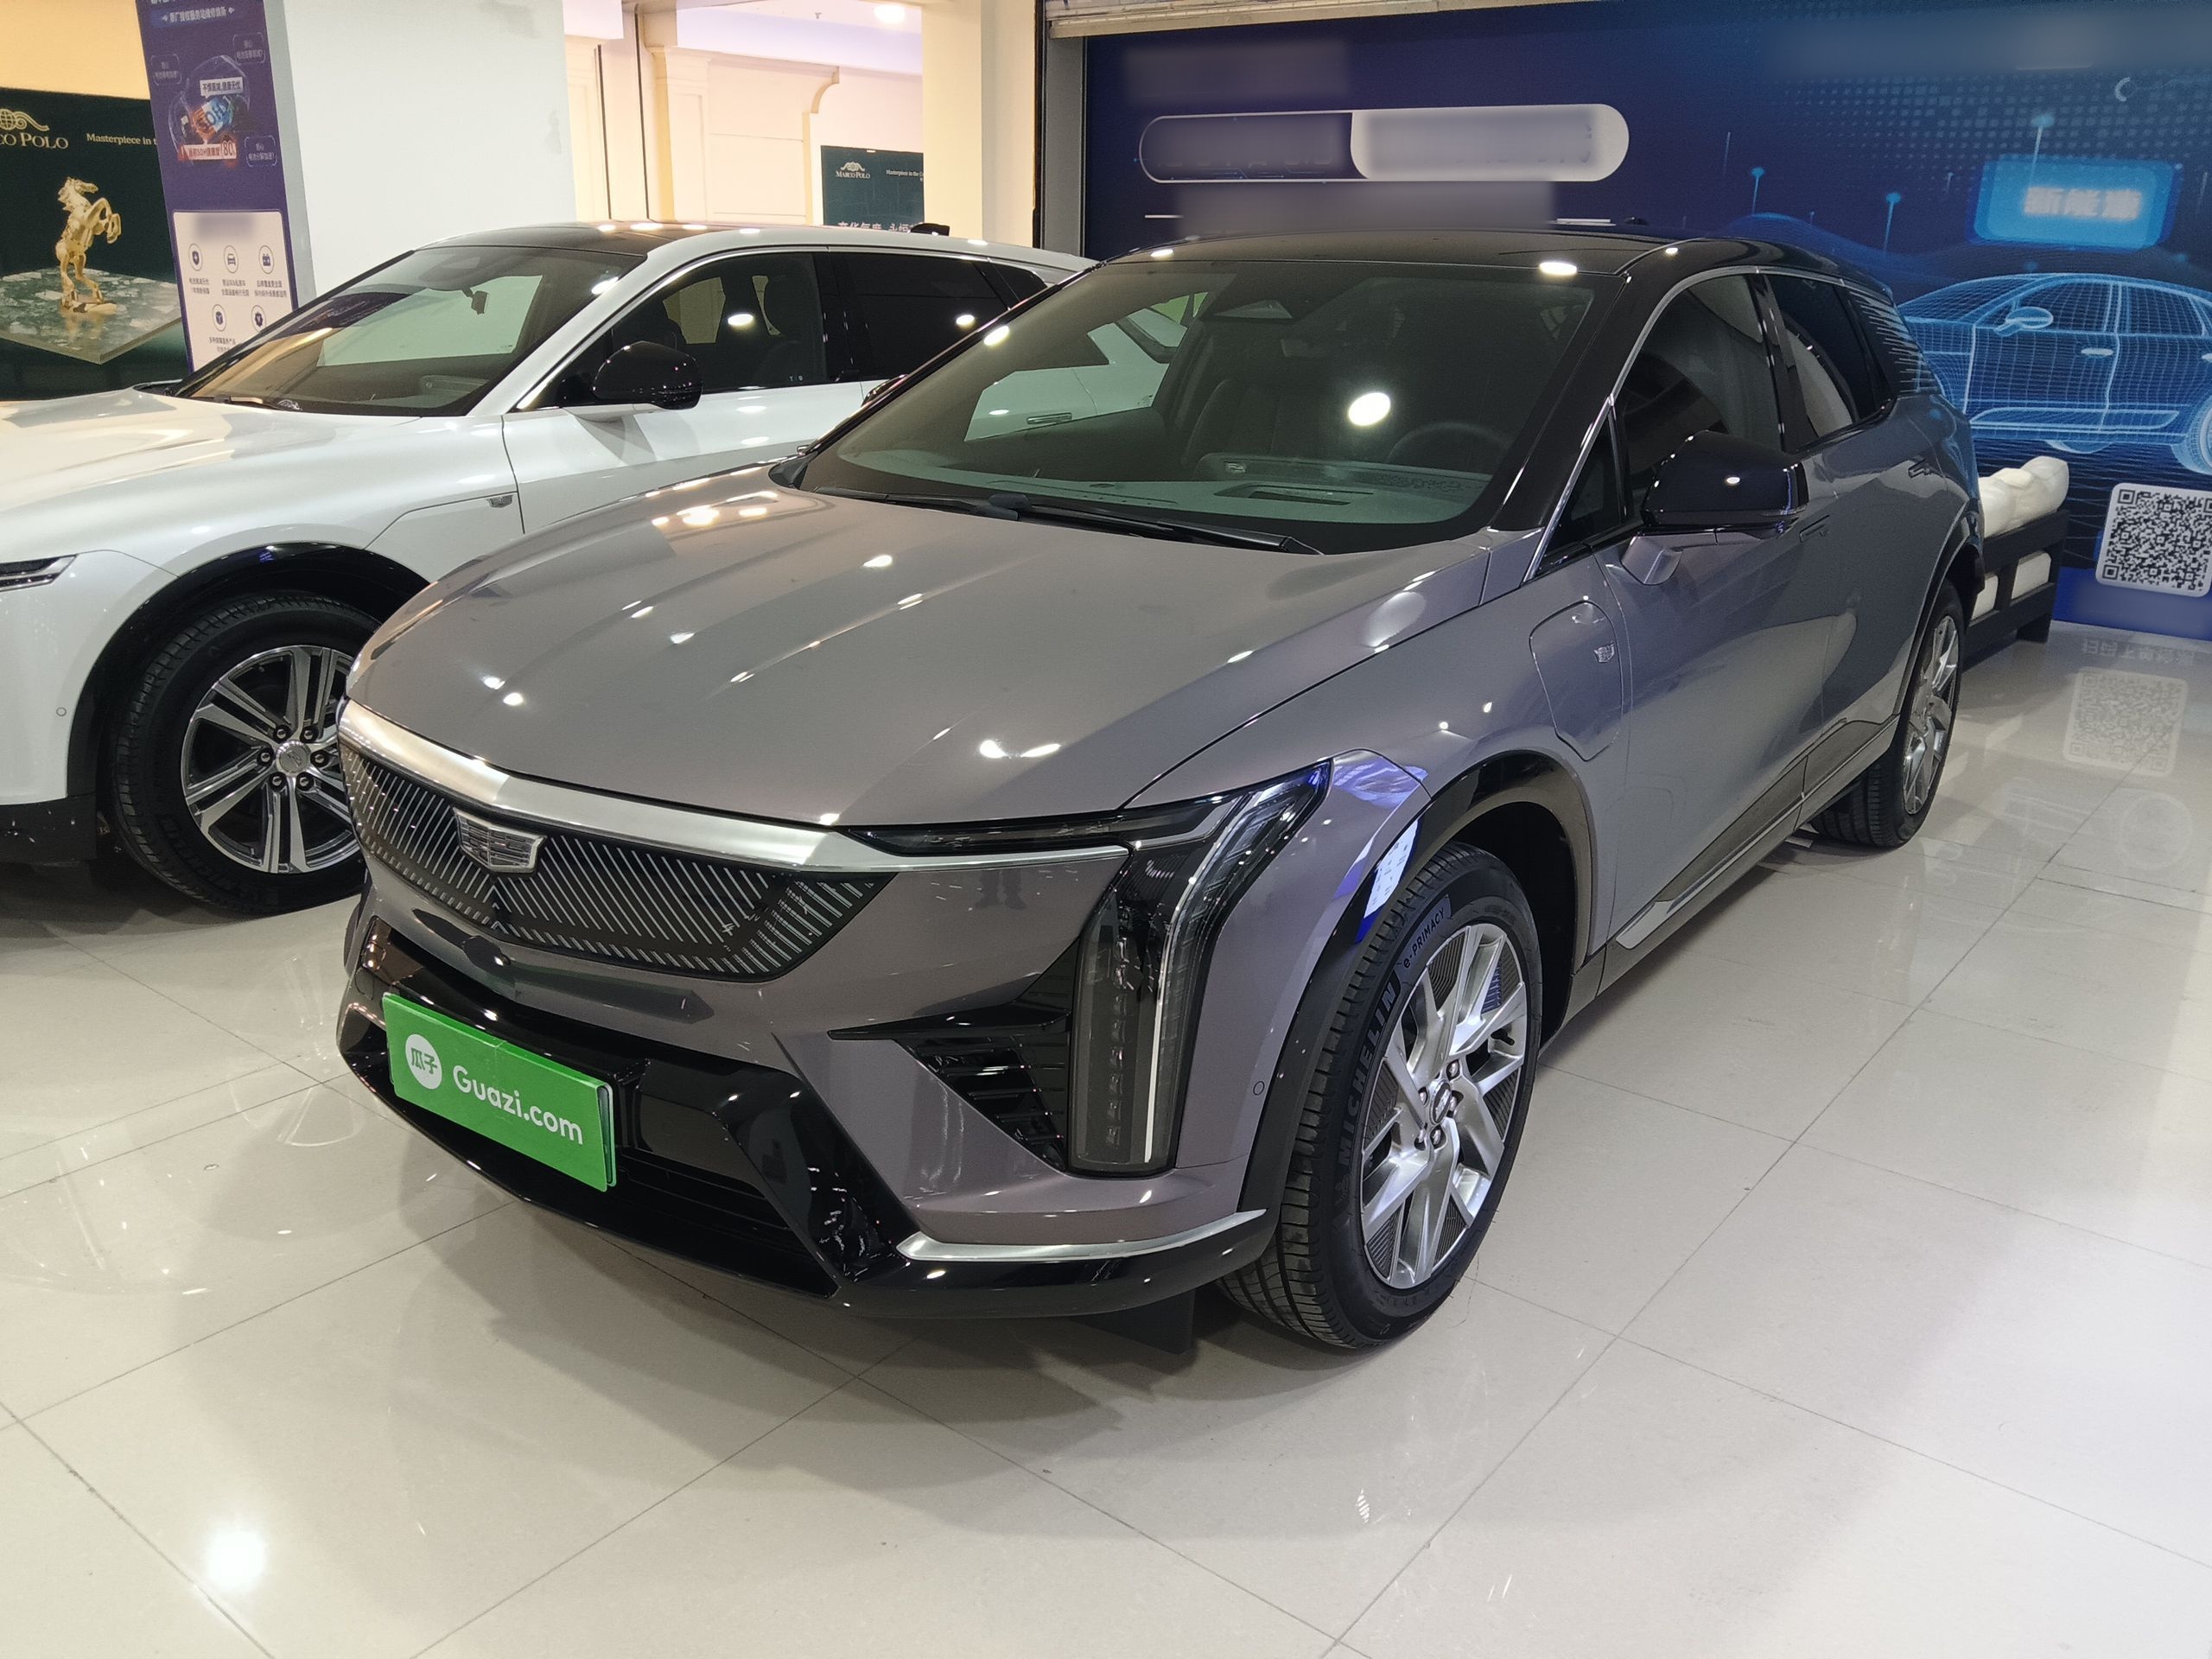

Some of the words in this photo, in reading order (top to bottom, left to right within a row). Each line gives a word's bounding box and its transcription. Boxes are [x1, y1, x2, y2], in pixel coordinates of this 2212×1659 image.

[20, 132, 69, 149] POLO
[86, 132, 141, 146] Masterpiece
[143, 137, 152, 146] in
[410, 1047, 438, 1075] 瓜子
[1339, 982, 1397, 1166] MICHELIN
[453, 1065, 583, 1145] Guazi.com
